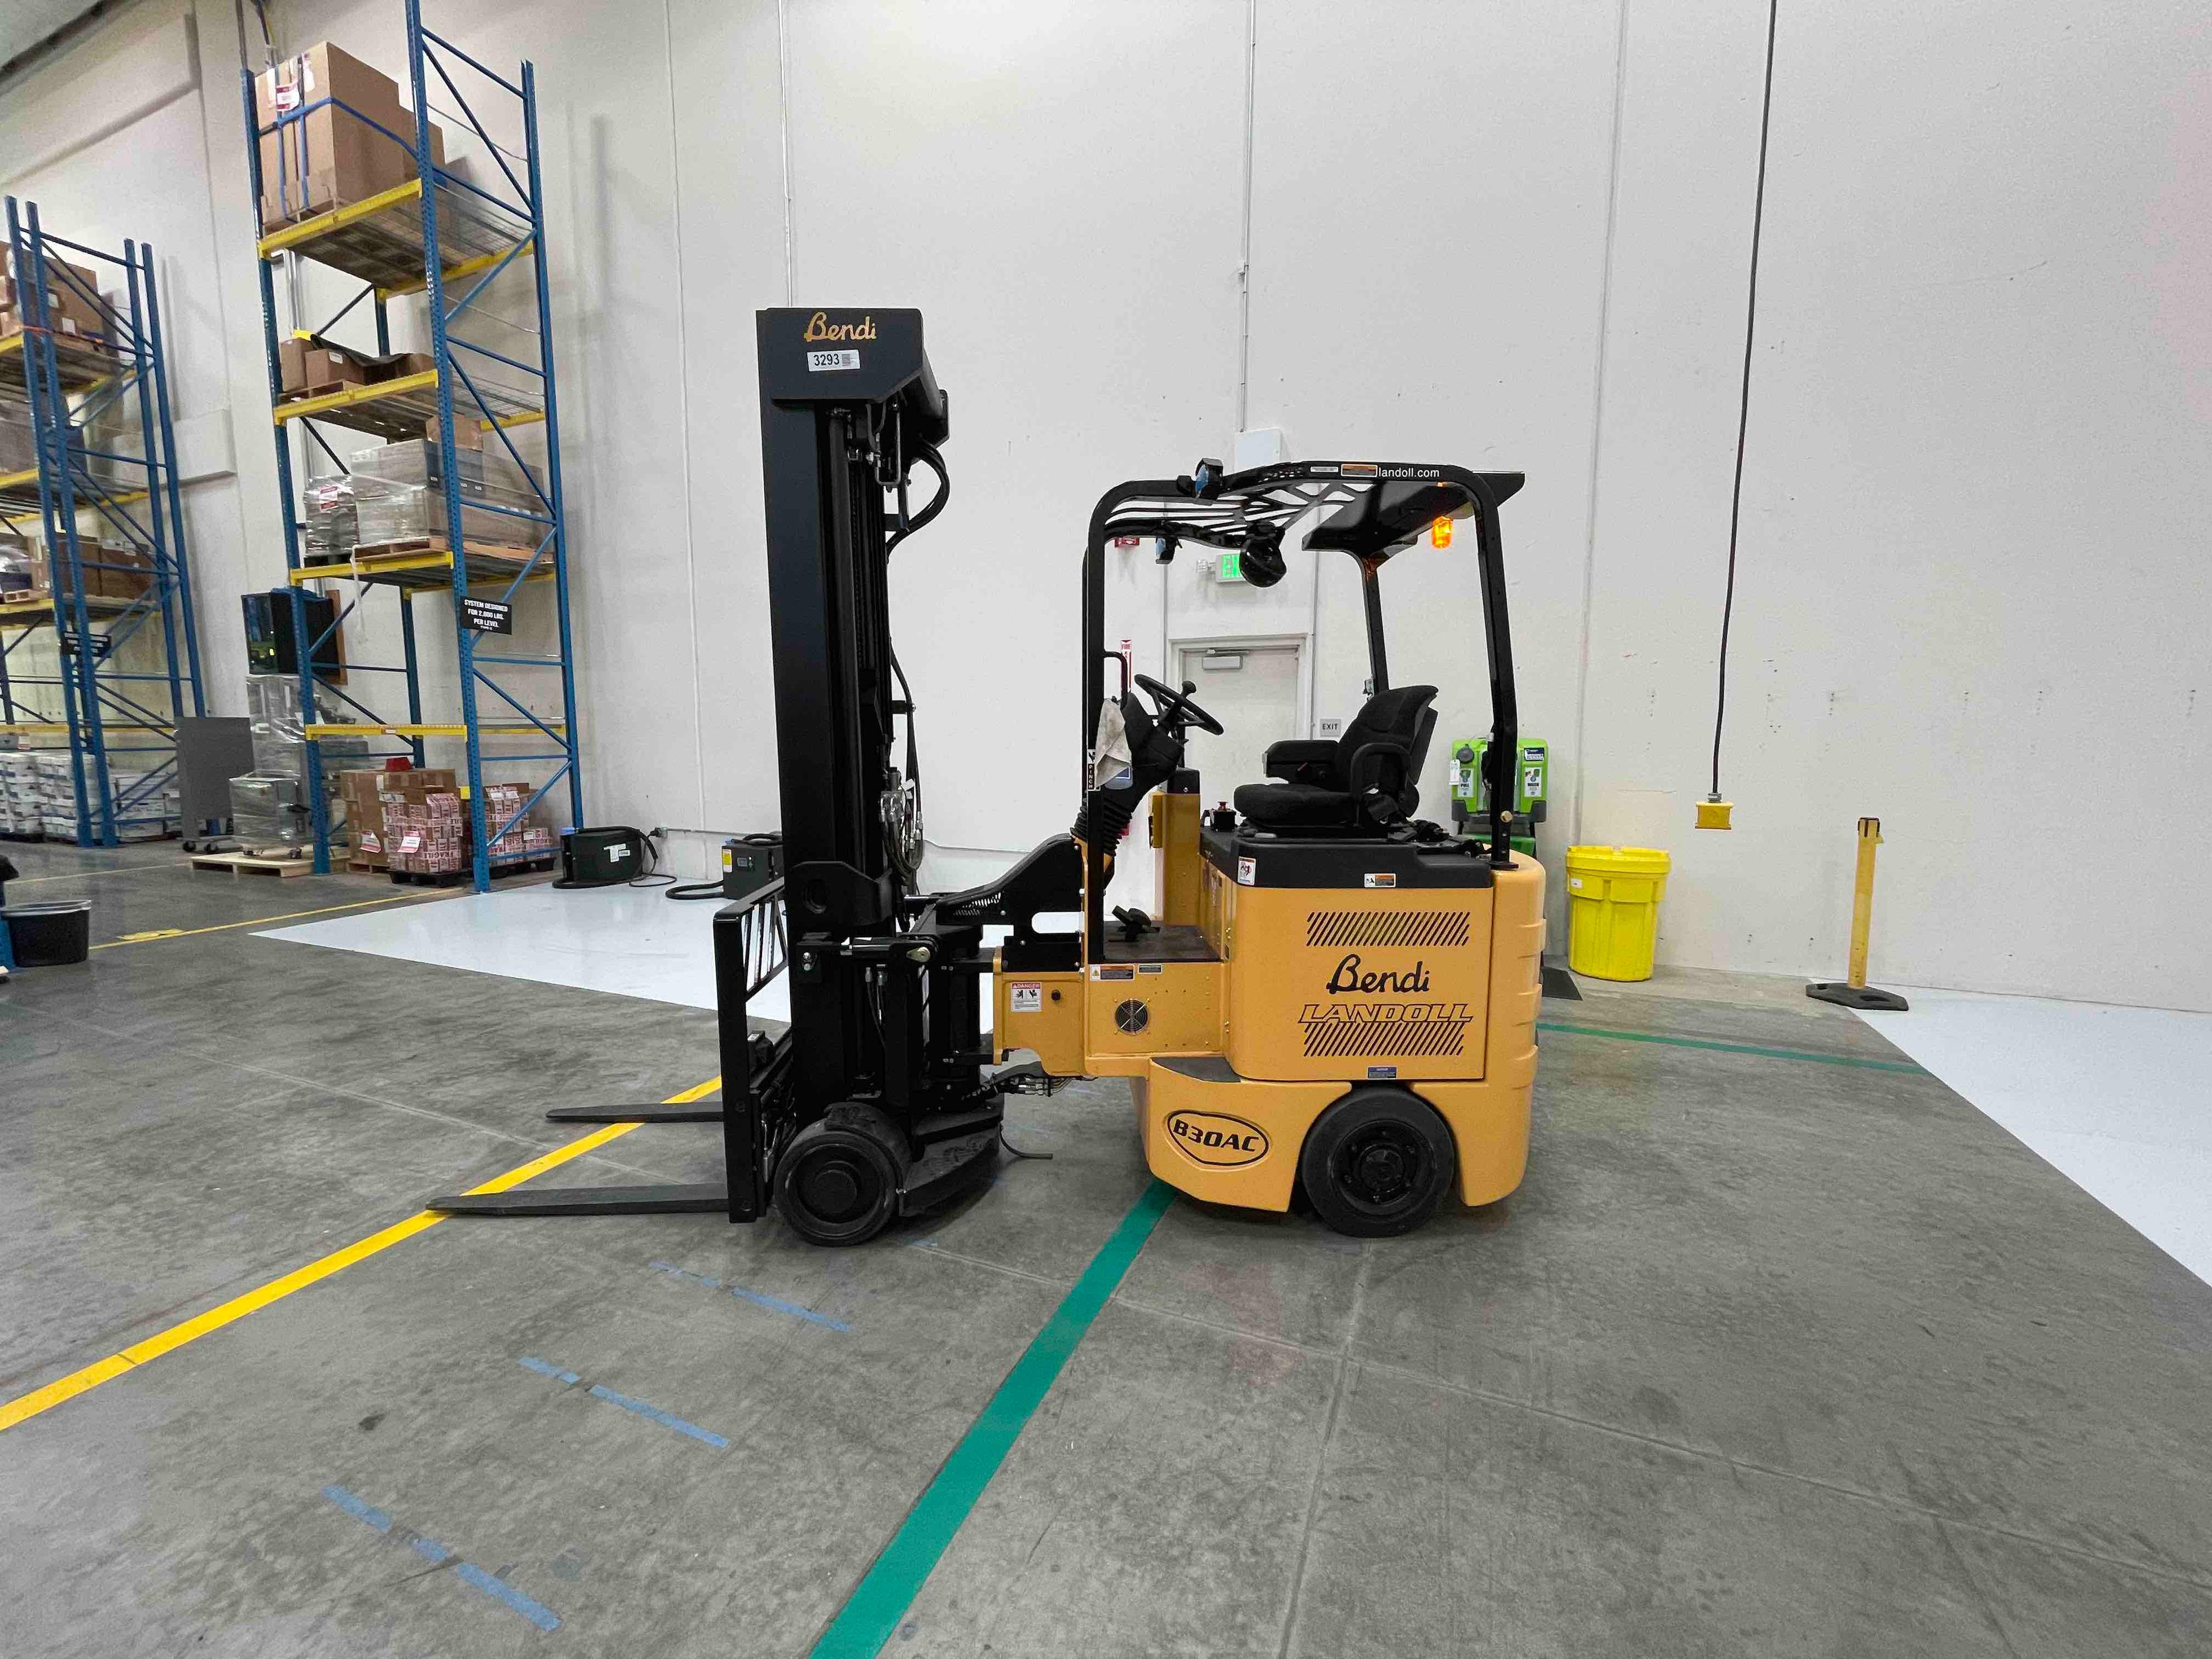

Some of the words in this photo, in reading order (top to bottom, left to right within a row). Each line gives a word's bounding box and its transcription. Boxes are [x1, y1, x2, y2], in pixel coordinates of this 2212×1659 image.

[804, 311, 877, 342] Bendi
[813, 353, 840, 366] 3293
[1378, 467, 1440, 478] landoll.com
[464, 599, 484, 608] SYSTEM
[1326, 954, 1430, 994] Bendi
[1298, 1004, 1474, 1022] LANDOLL
[1173, 1119, 1259, 1152] B30AC
